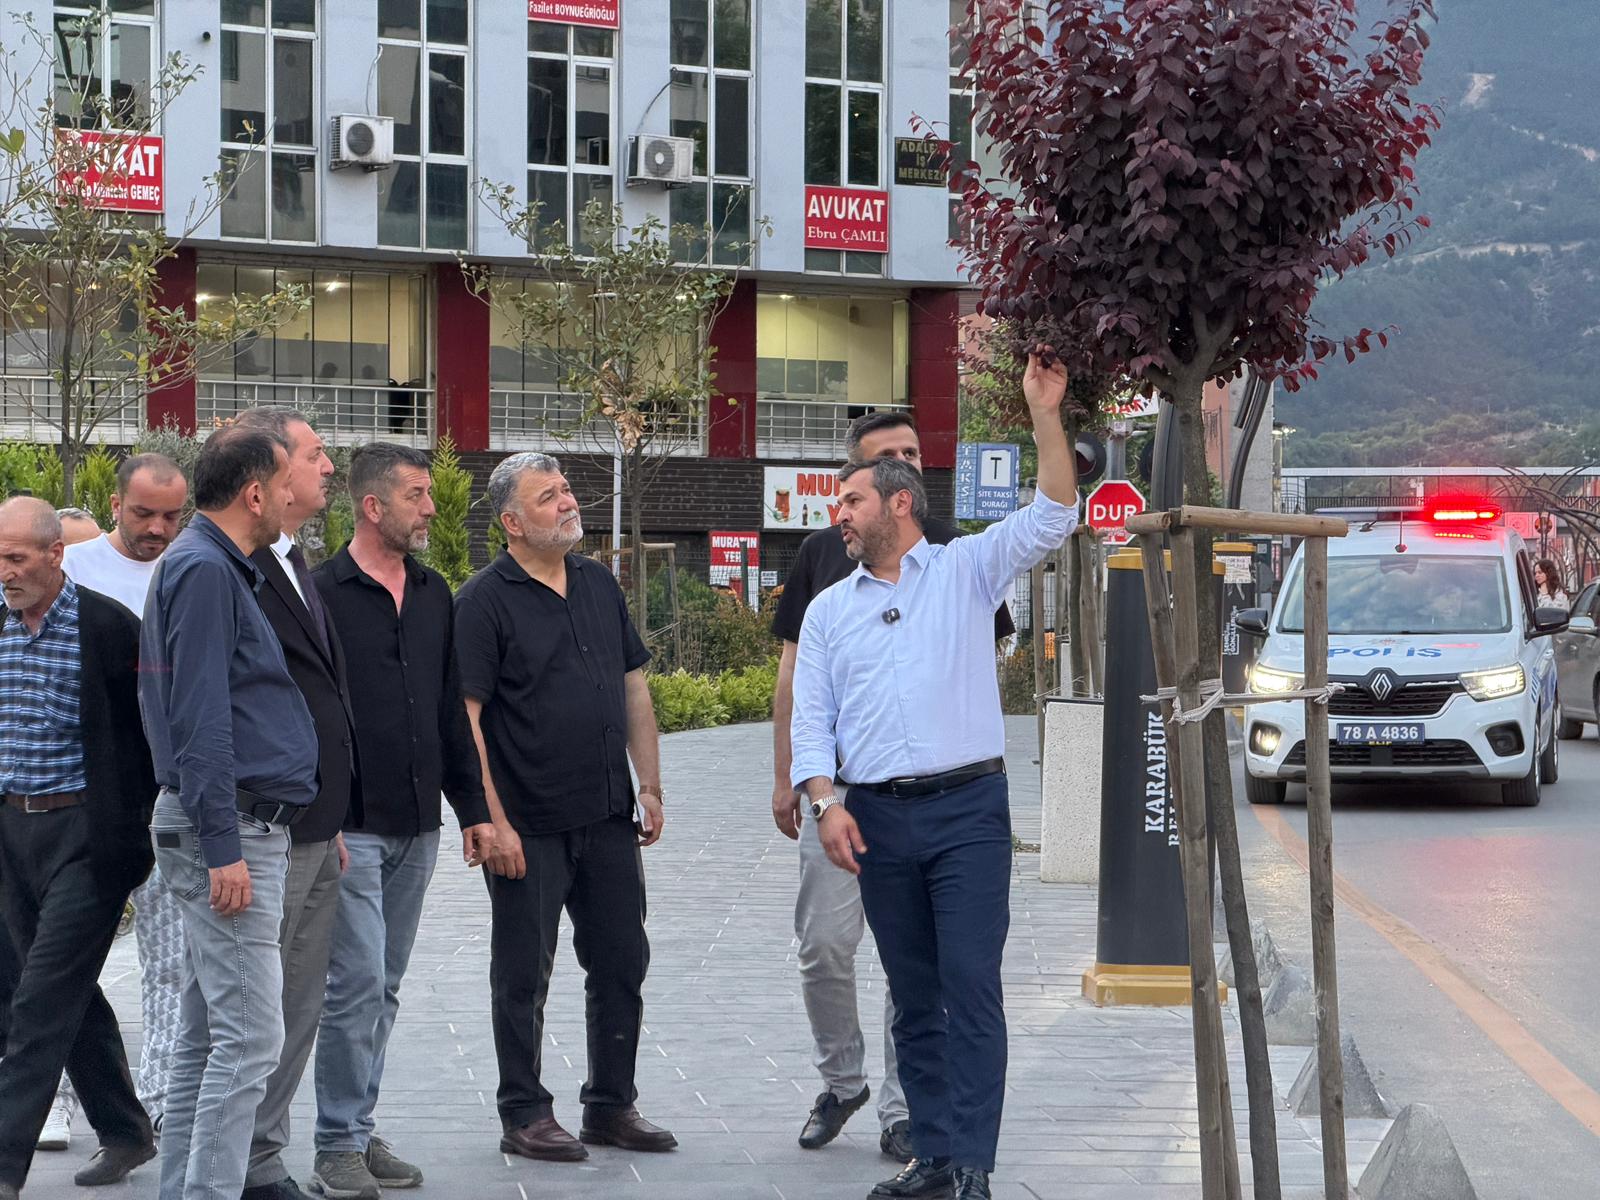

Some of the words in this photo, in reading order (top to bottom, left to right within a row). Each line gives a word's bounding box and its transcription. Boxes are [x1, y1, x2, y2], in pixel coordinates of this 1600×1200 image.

[529, 2, 553, 14] Fazilet
[900, 141, 939, 153] ADALE
[131, 184, 160, 205] GEMEÇ
[807, 195, 885, 222] AVUKAT
[808, 226, 837, 239] Ebru
[841, 228, 885, 243] ÇAMLI
[990, 457, 1002, 480] T
[1093, 504, 1137, 521] DUR
[1343, 727, 1361, 739] 78
[1366, 727, 1377, 739] A
[1381, 727, 1418, 739] 4836
[1143, 711, 1167, 833] KARABÜK
